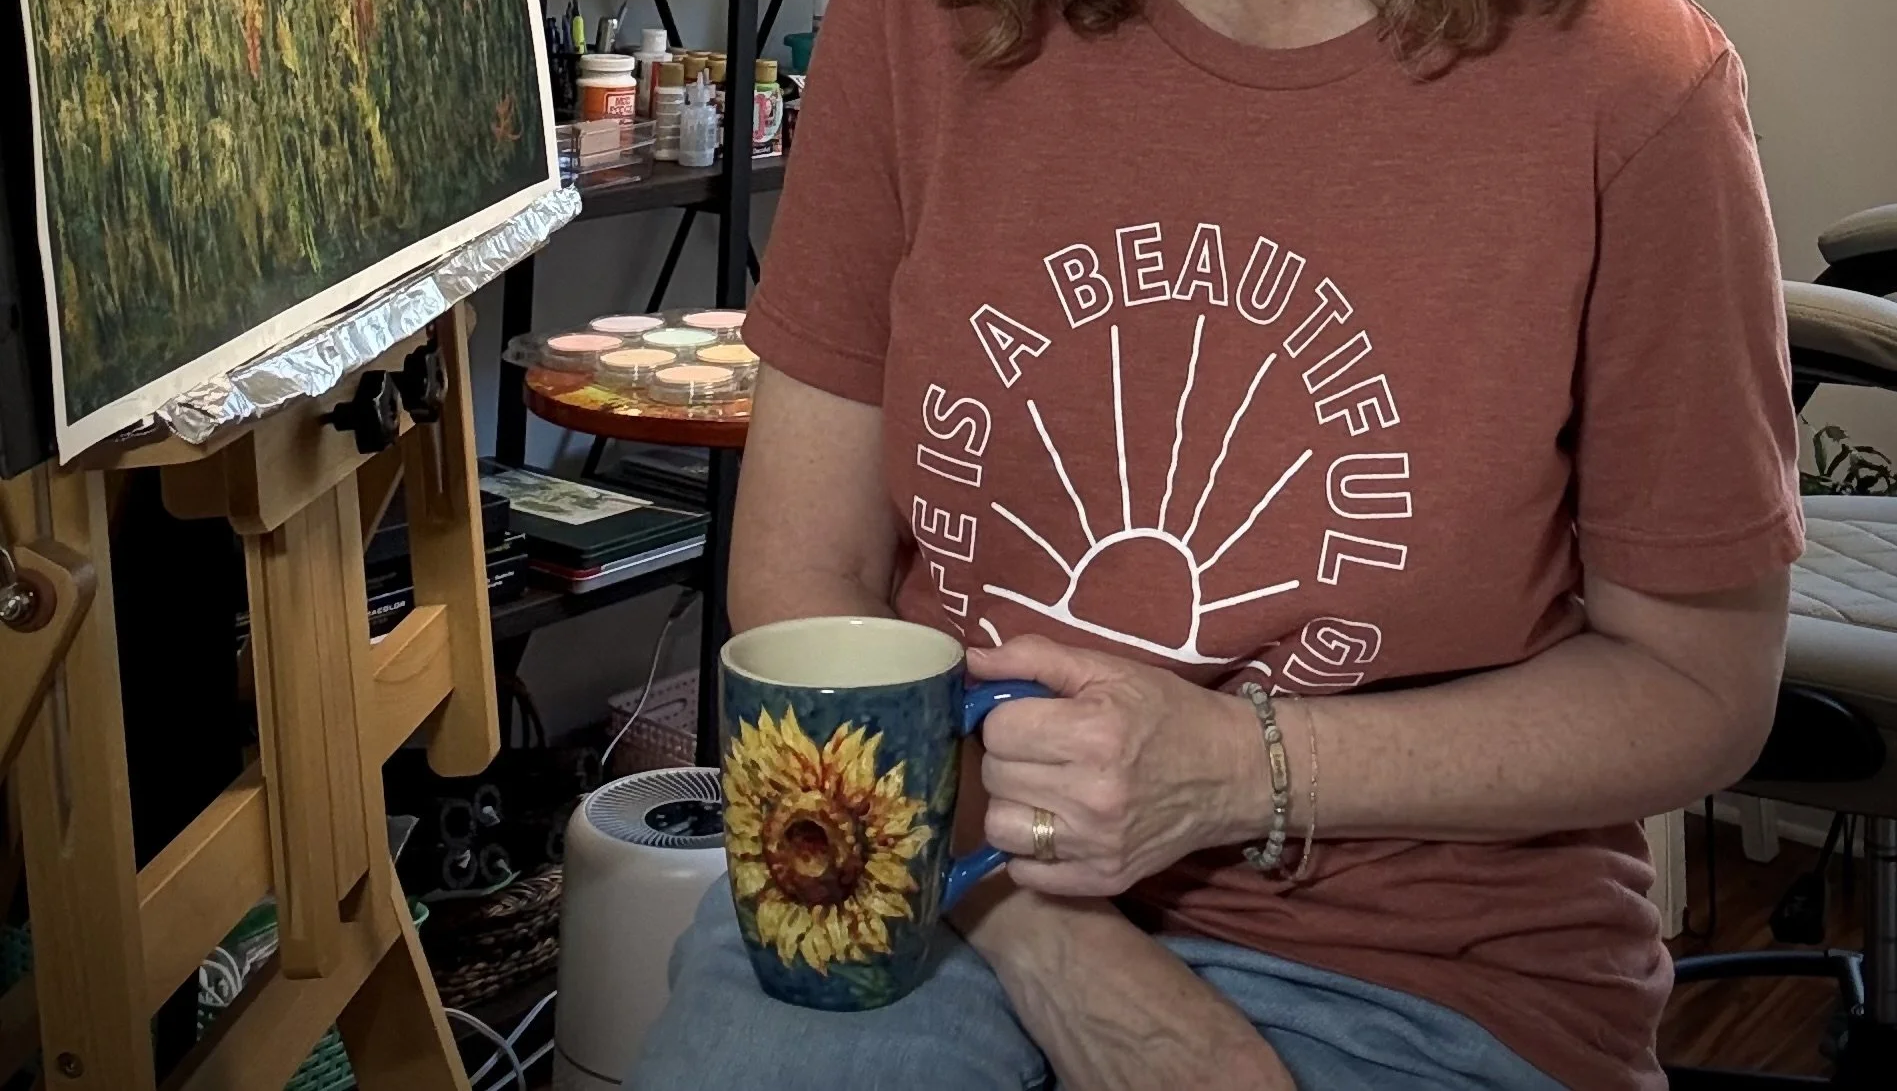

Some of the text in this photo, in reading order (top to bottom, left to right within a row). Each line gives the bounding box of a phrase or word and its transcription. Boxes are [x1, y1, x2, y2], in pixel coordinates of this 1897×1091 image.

[911, 222, 1413, 697] FE IS A BEAUTIFUL GI
